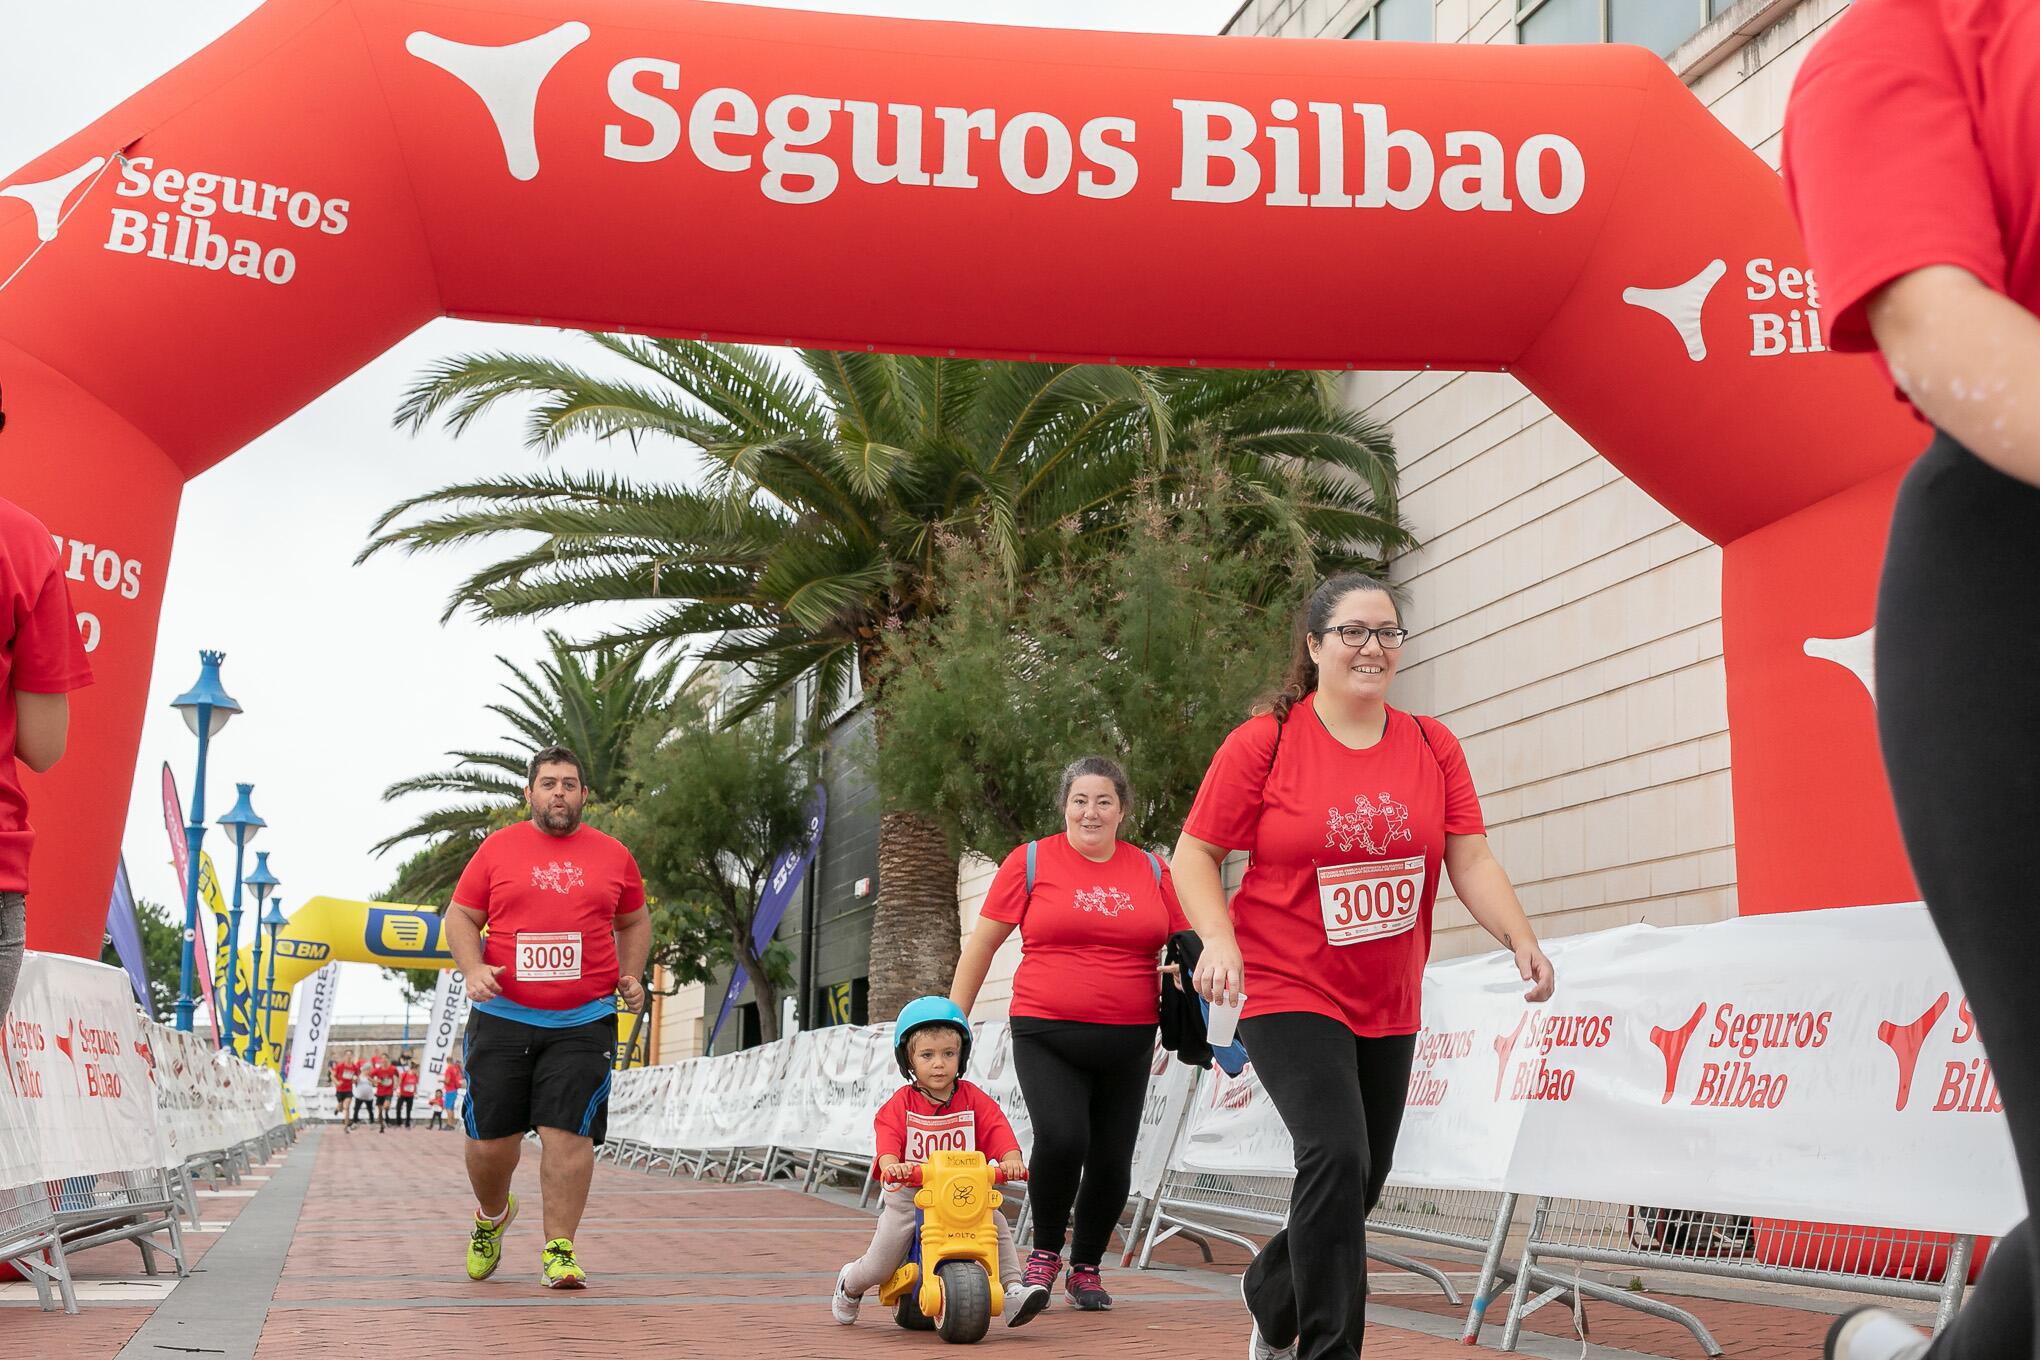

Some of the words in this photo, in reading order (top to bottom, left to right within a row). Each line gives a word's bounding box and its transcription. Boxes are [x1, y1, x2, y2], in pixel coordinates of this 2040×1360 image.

[603, 57, 1139, 204] Seguros
[1171, 98, 1587, 214] Bilbao
[115, 156, 350, 235] Seguros
[103, 207, 296, 285] Bilbao
[1749, 309, 1828, 356] Bil
[1333, 879, 1415, 926] 3009
[296, 943, 326, 959] BM
[523, 945, 575, 969] 3009
[436, 970, 464, 1048] CORREO
[1525, 1009, 1614, 1056] Seguros
[1709, 1002, 1832, 1058] Seguros
[1415, 1026, 1475, 1069] Seguros
[1406, 1070, 1449, 1107] ilbao
[1510, 1058, 1576, 1102] Bilbao
[1690, 1061, 1788, 1109] Bilbao
[948, 1232, 976, 1240] MOLTO
